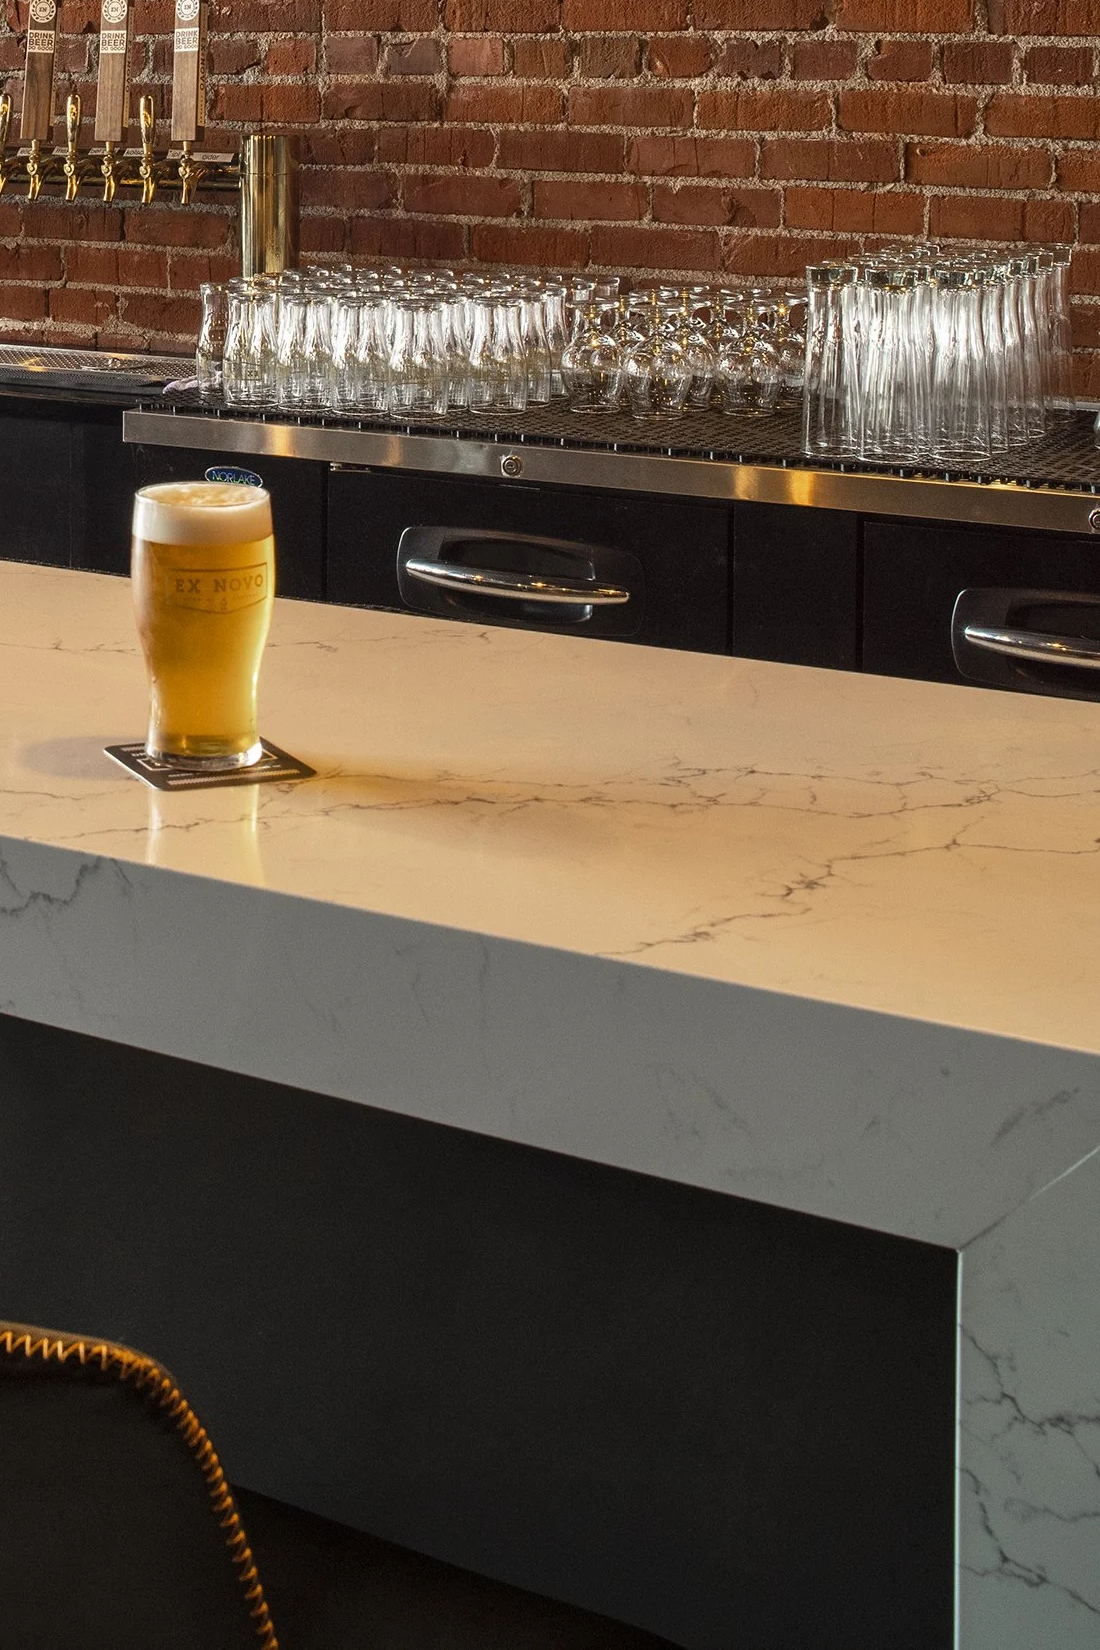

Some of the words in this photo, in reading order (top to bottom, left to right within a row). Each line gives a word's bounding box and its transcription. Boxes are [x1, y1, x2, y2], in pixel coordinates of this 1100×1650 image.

[29, 32, 54, 40] DRINK
[28, 38, 54, 47] BEER
[101, 39, 126, 47] BEER
[175, 37, 198, 46] BEER
[211, 469, 257, 487] NORLAKE
[175, 577, 202, 594] EX
[213, 573, 264, 593] NOVO
